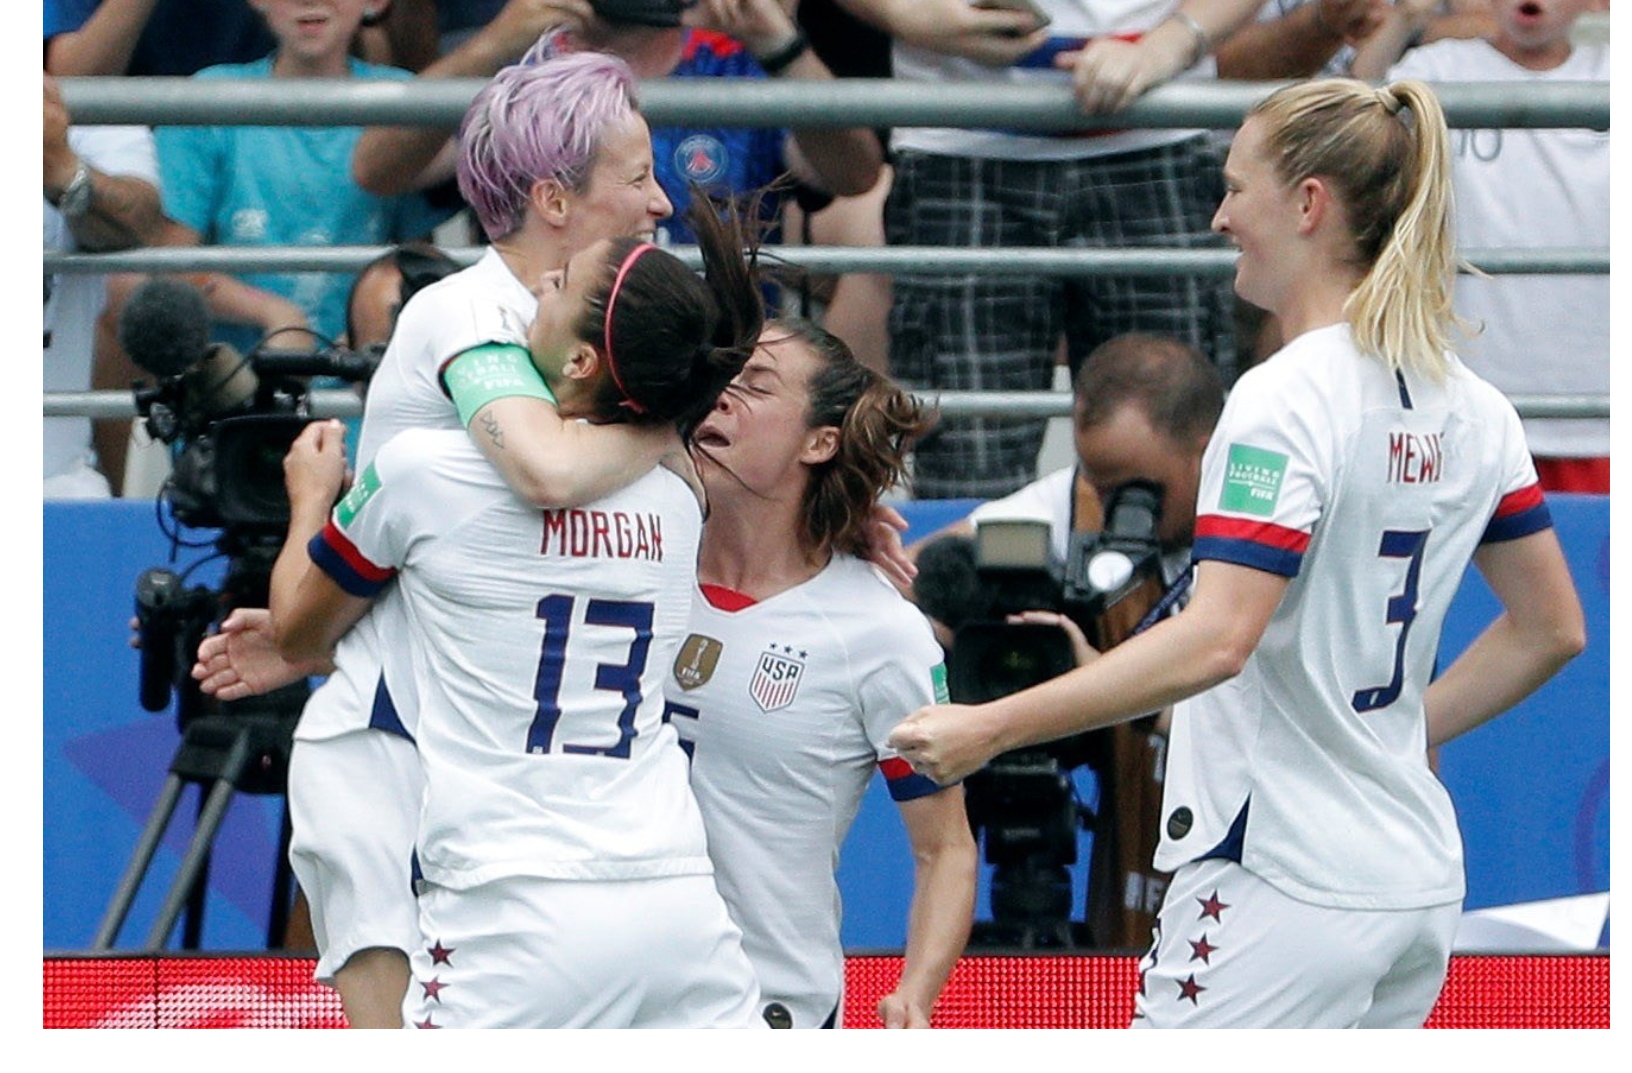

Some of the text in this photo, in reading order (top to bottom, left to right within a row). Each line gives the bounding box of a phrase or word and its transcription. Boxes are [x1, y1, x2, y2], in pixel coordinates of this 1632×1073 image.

[539, 509, 665, 563] MORGAN
[761, 657, 799, 682] USA
[1351, 529, 1433, 713] 3
[526, 593, 656, 761] 13
